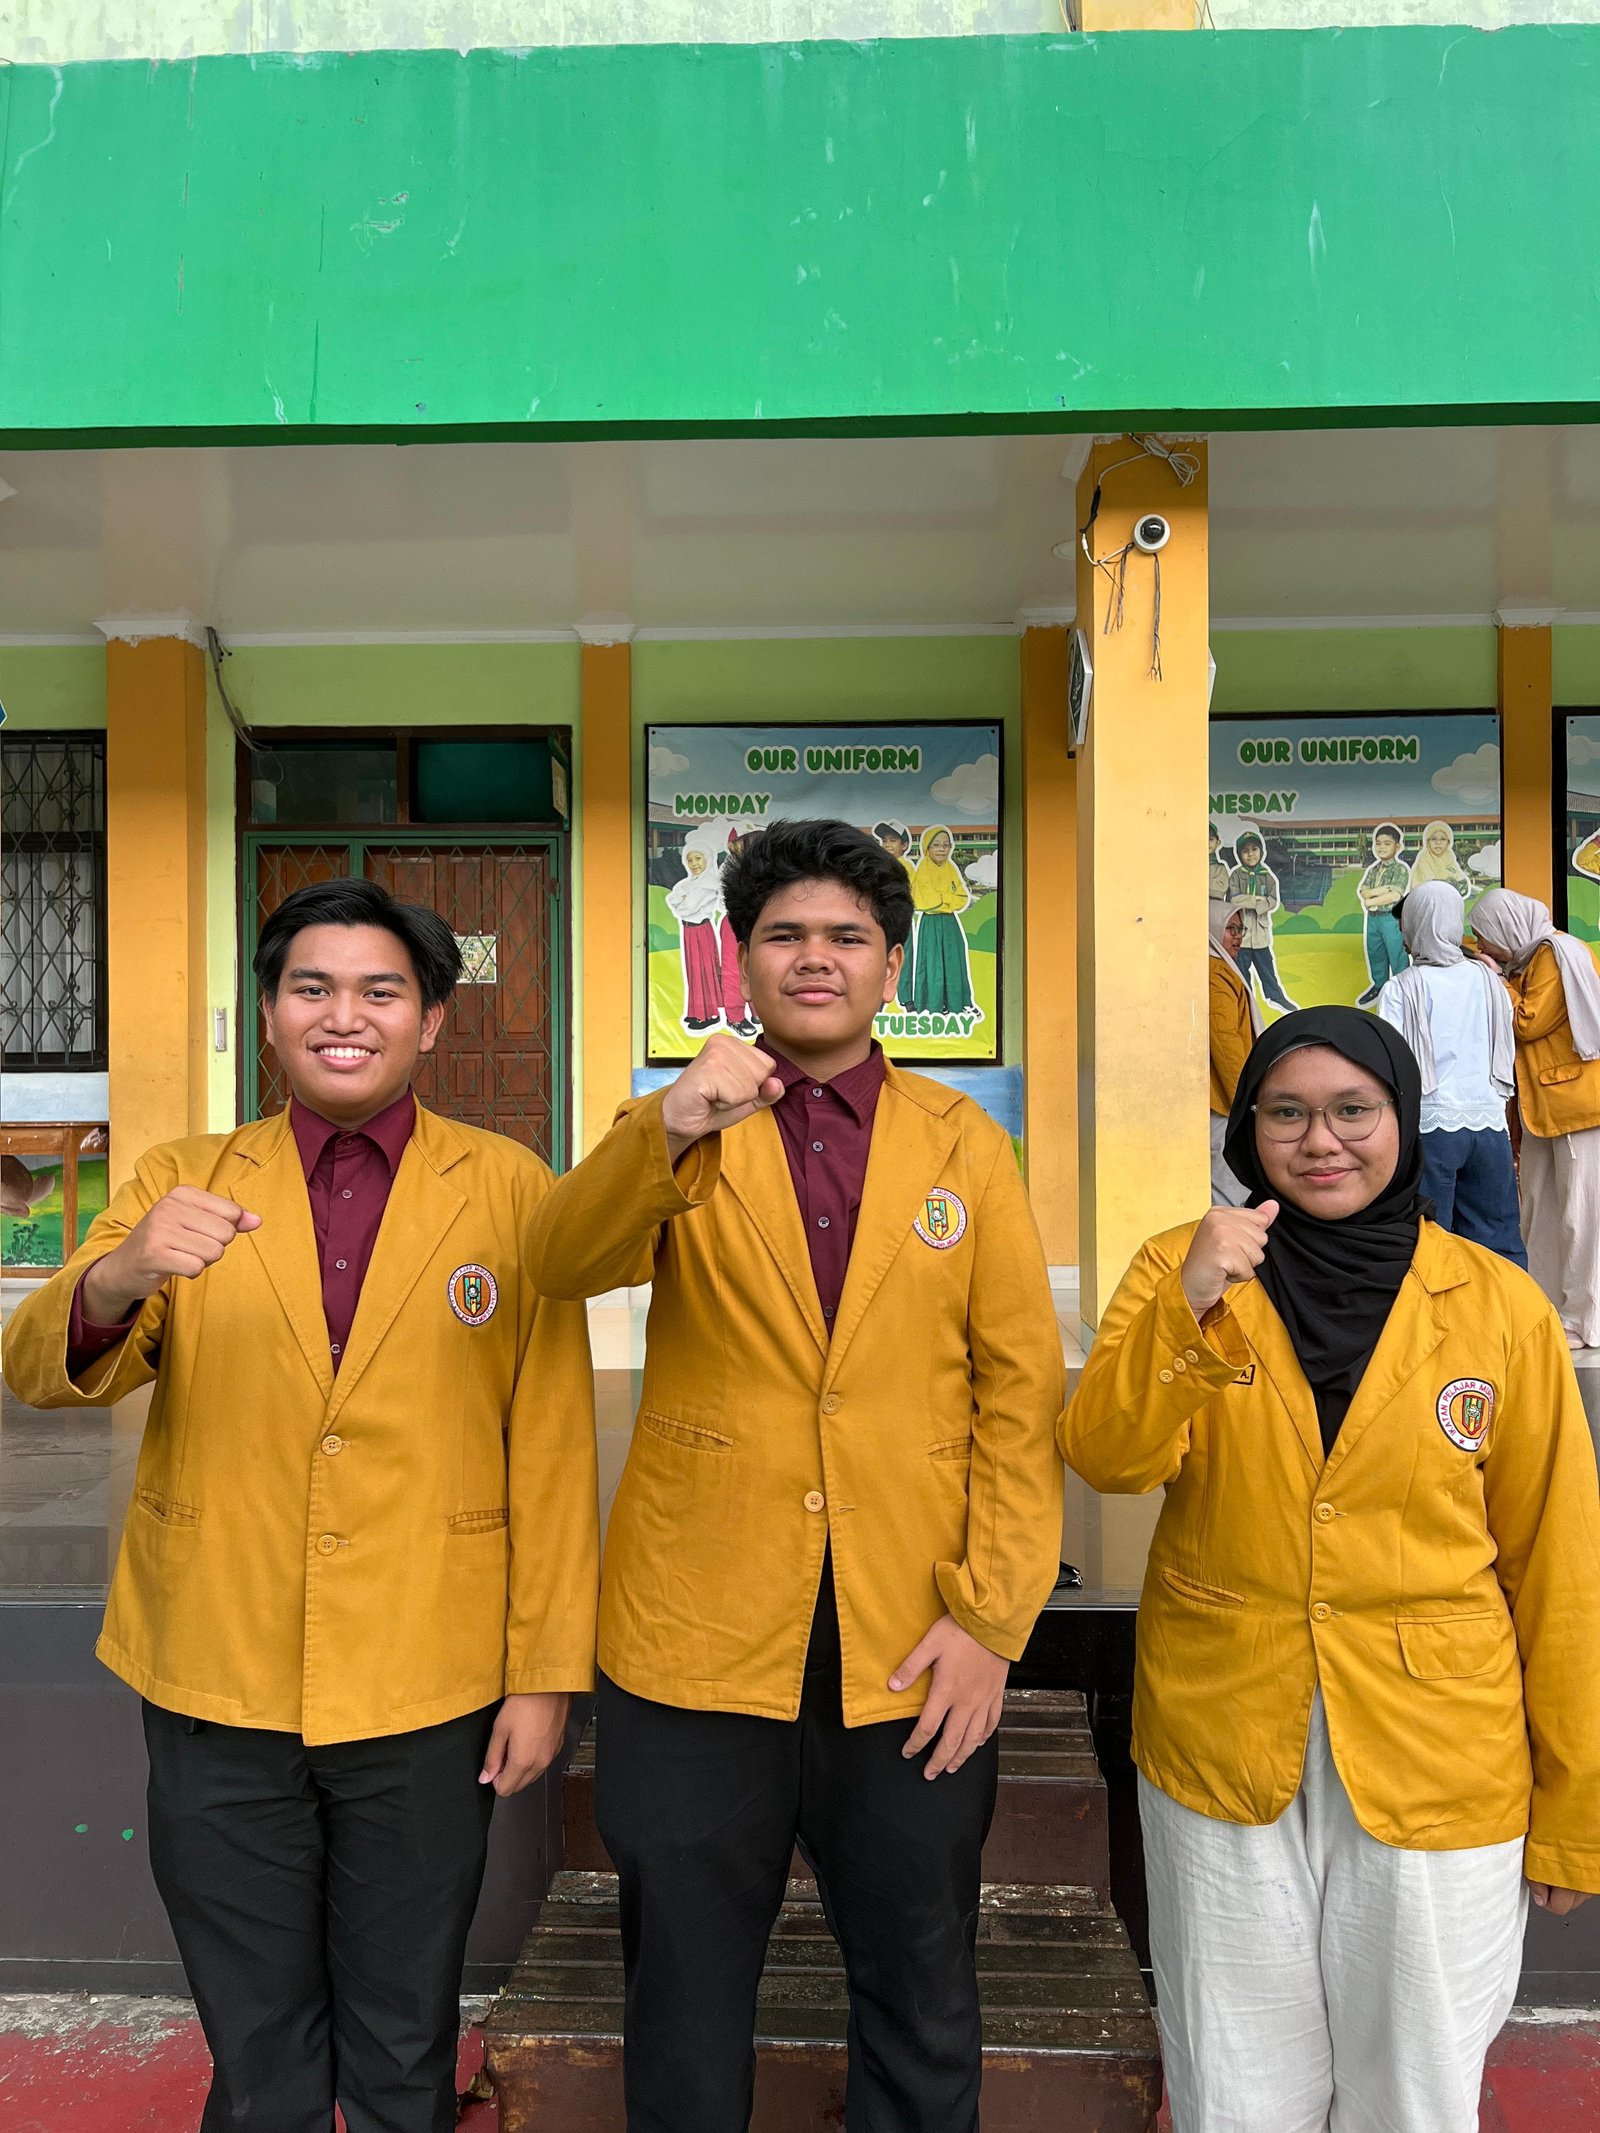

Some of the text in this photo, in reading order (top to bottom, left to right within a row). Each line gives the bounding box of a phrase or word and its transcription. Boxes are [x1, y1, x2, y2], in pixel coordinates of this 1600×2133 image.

[746, 747, 920, 772] OUR UNIFORM
[1239, 738, 1418, 765] OUR UNIFORM
[674, 793, 771, 816] MONDAY
[1209, 792, 1297, 815] NESDAY
[874, 1014, 975, 1037] TUESDAY
[1440, 1381, 1476, 1436] IKATAN PELAJAR
